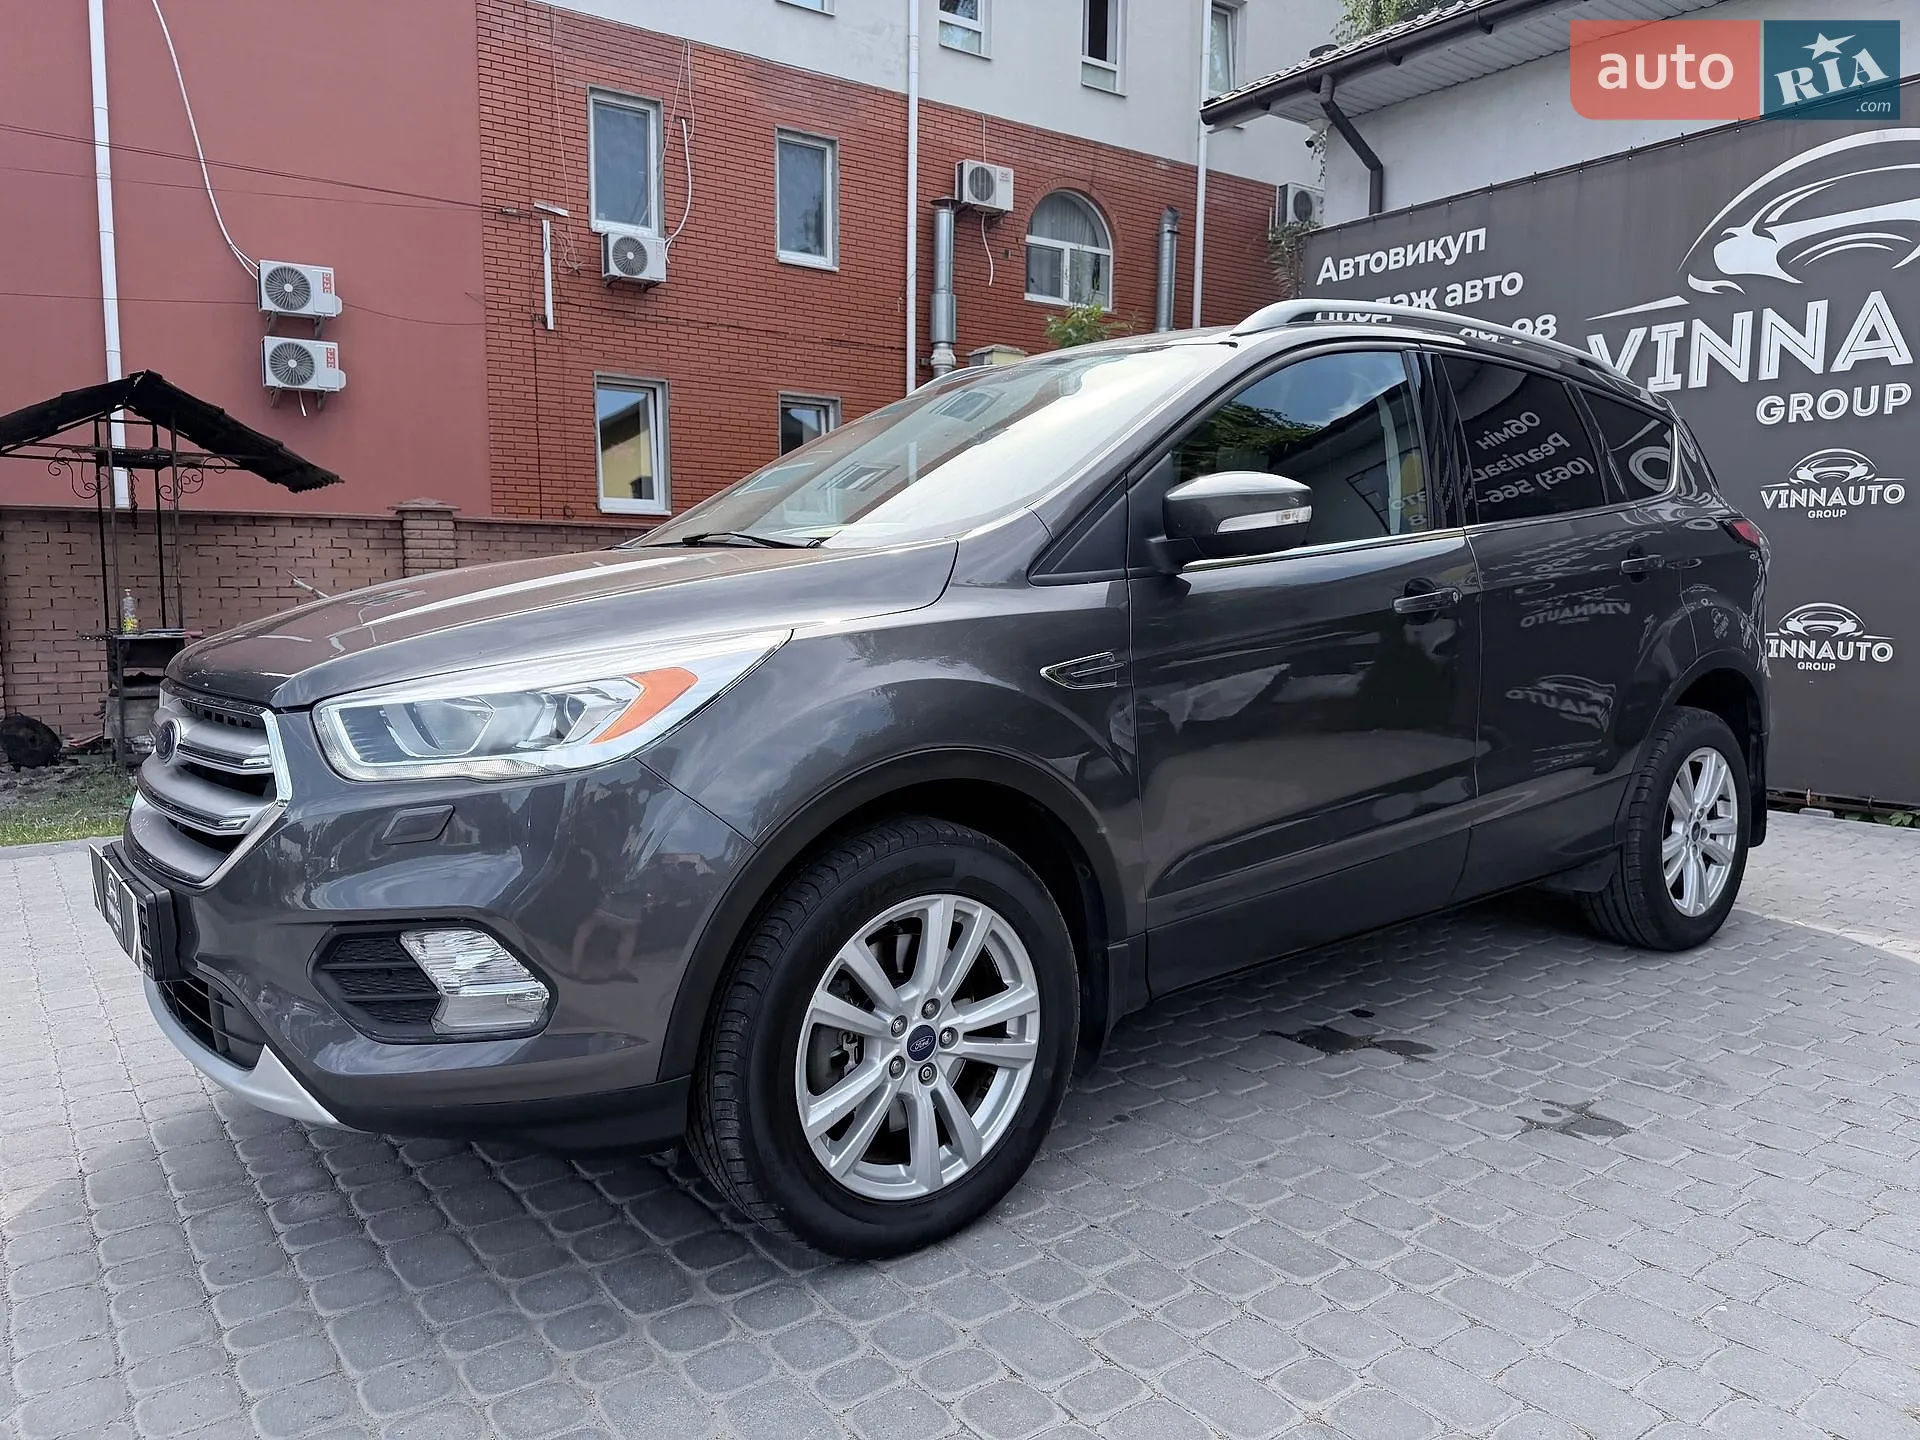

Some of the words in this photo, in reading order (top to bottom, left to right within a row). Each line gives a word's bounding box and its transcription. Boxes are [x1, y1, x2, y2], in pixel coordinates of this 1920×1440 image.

[1316, 227, 1487, 286] Автовикуп
[1444, 271, 1524, 308] авто
[1586, 290, 1914, 394] VINNA
[1755, 382, 1913, 426] GROUP
[1760, 483, 1906, 510] VINNAUTO
[1807, 509, 1847, 519] GROUP
[1766, 639, 1894, 663] INNAUTO
[1797, 661, 1836, 671] GROUP
